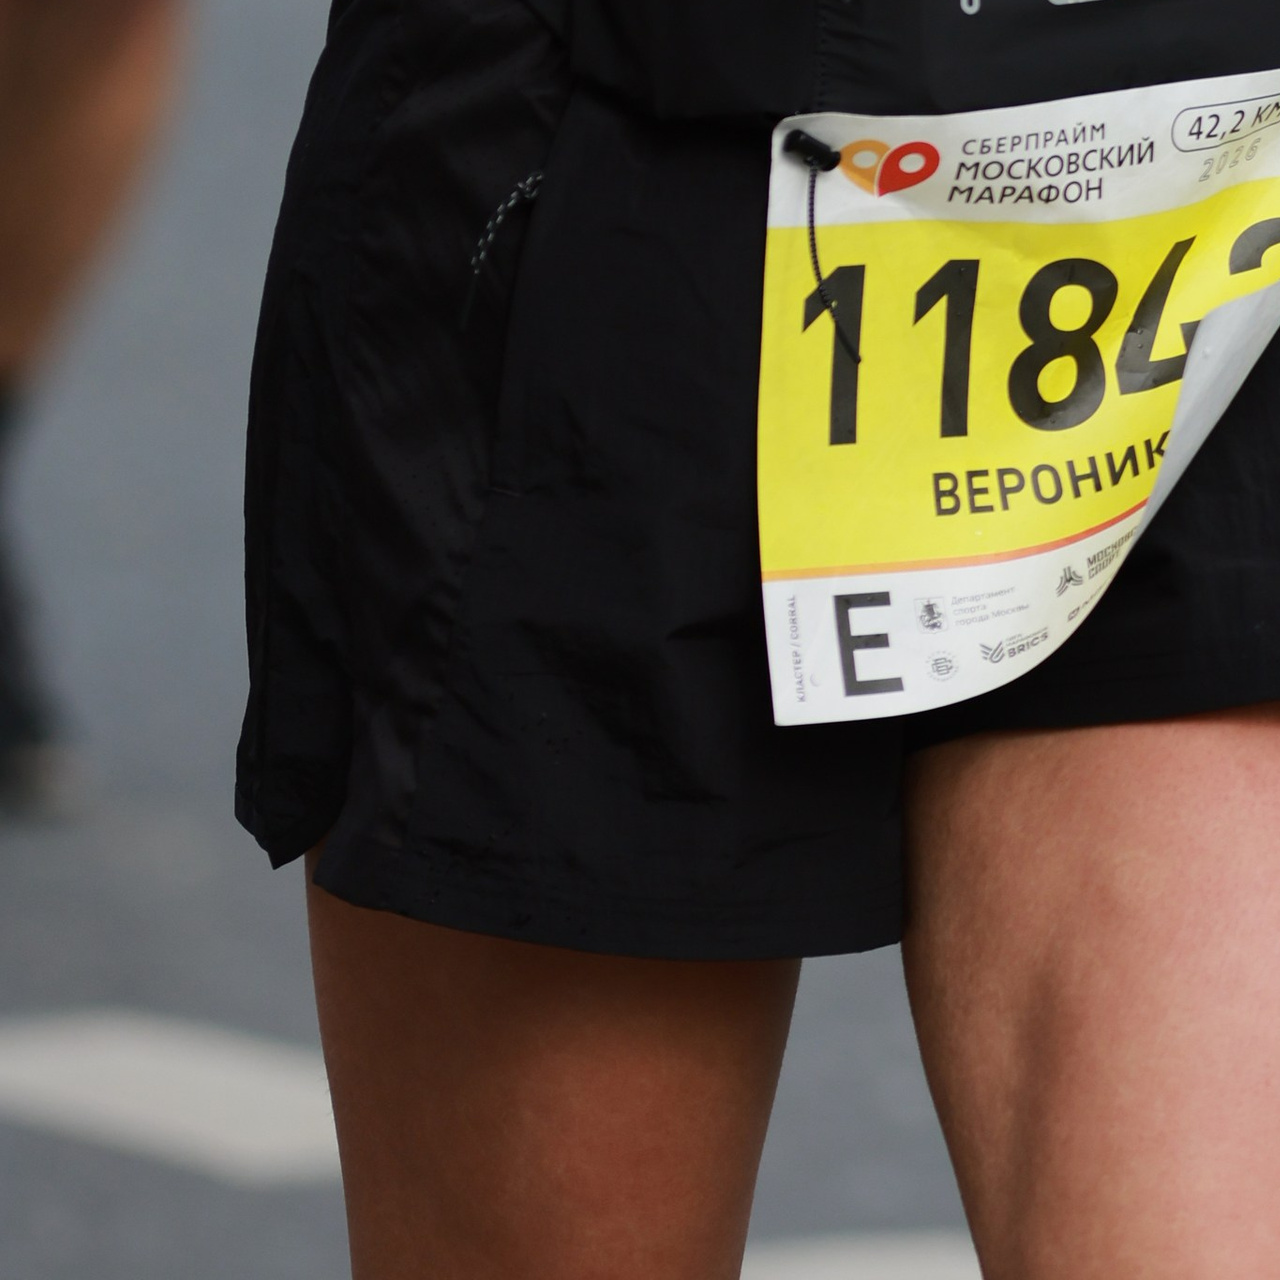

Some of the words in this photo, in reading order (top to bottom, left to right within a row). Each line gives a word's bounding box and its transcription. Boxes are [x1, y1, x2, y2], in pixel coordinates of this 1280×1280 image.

[961, 123, 1105, 155] СБЕРПРАЙМ
[1188, 109, 1245, 141] 42,2
[954, 140, 1155, 181] МОСКОВСКИЙ
[947, 178, 1103, 204] МАРАФОН
[833, 591, 905, 697] E
[1007, 631, 1049, 659] BRICS
